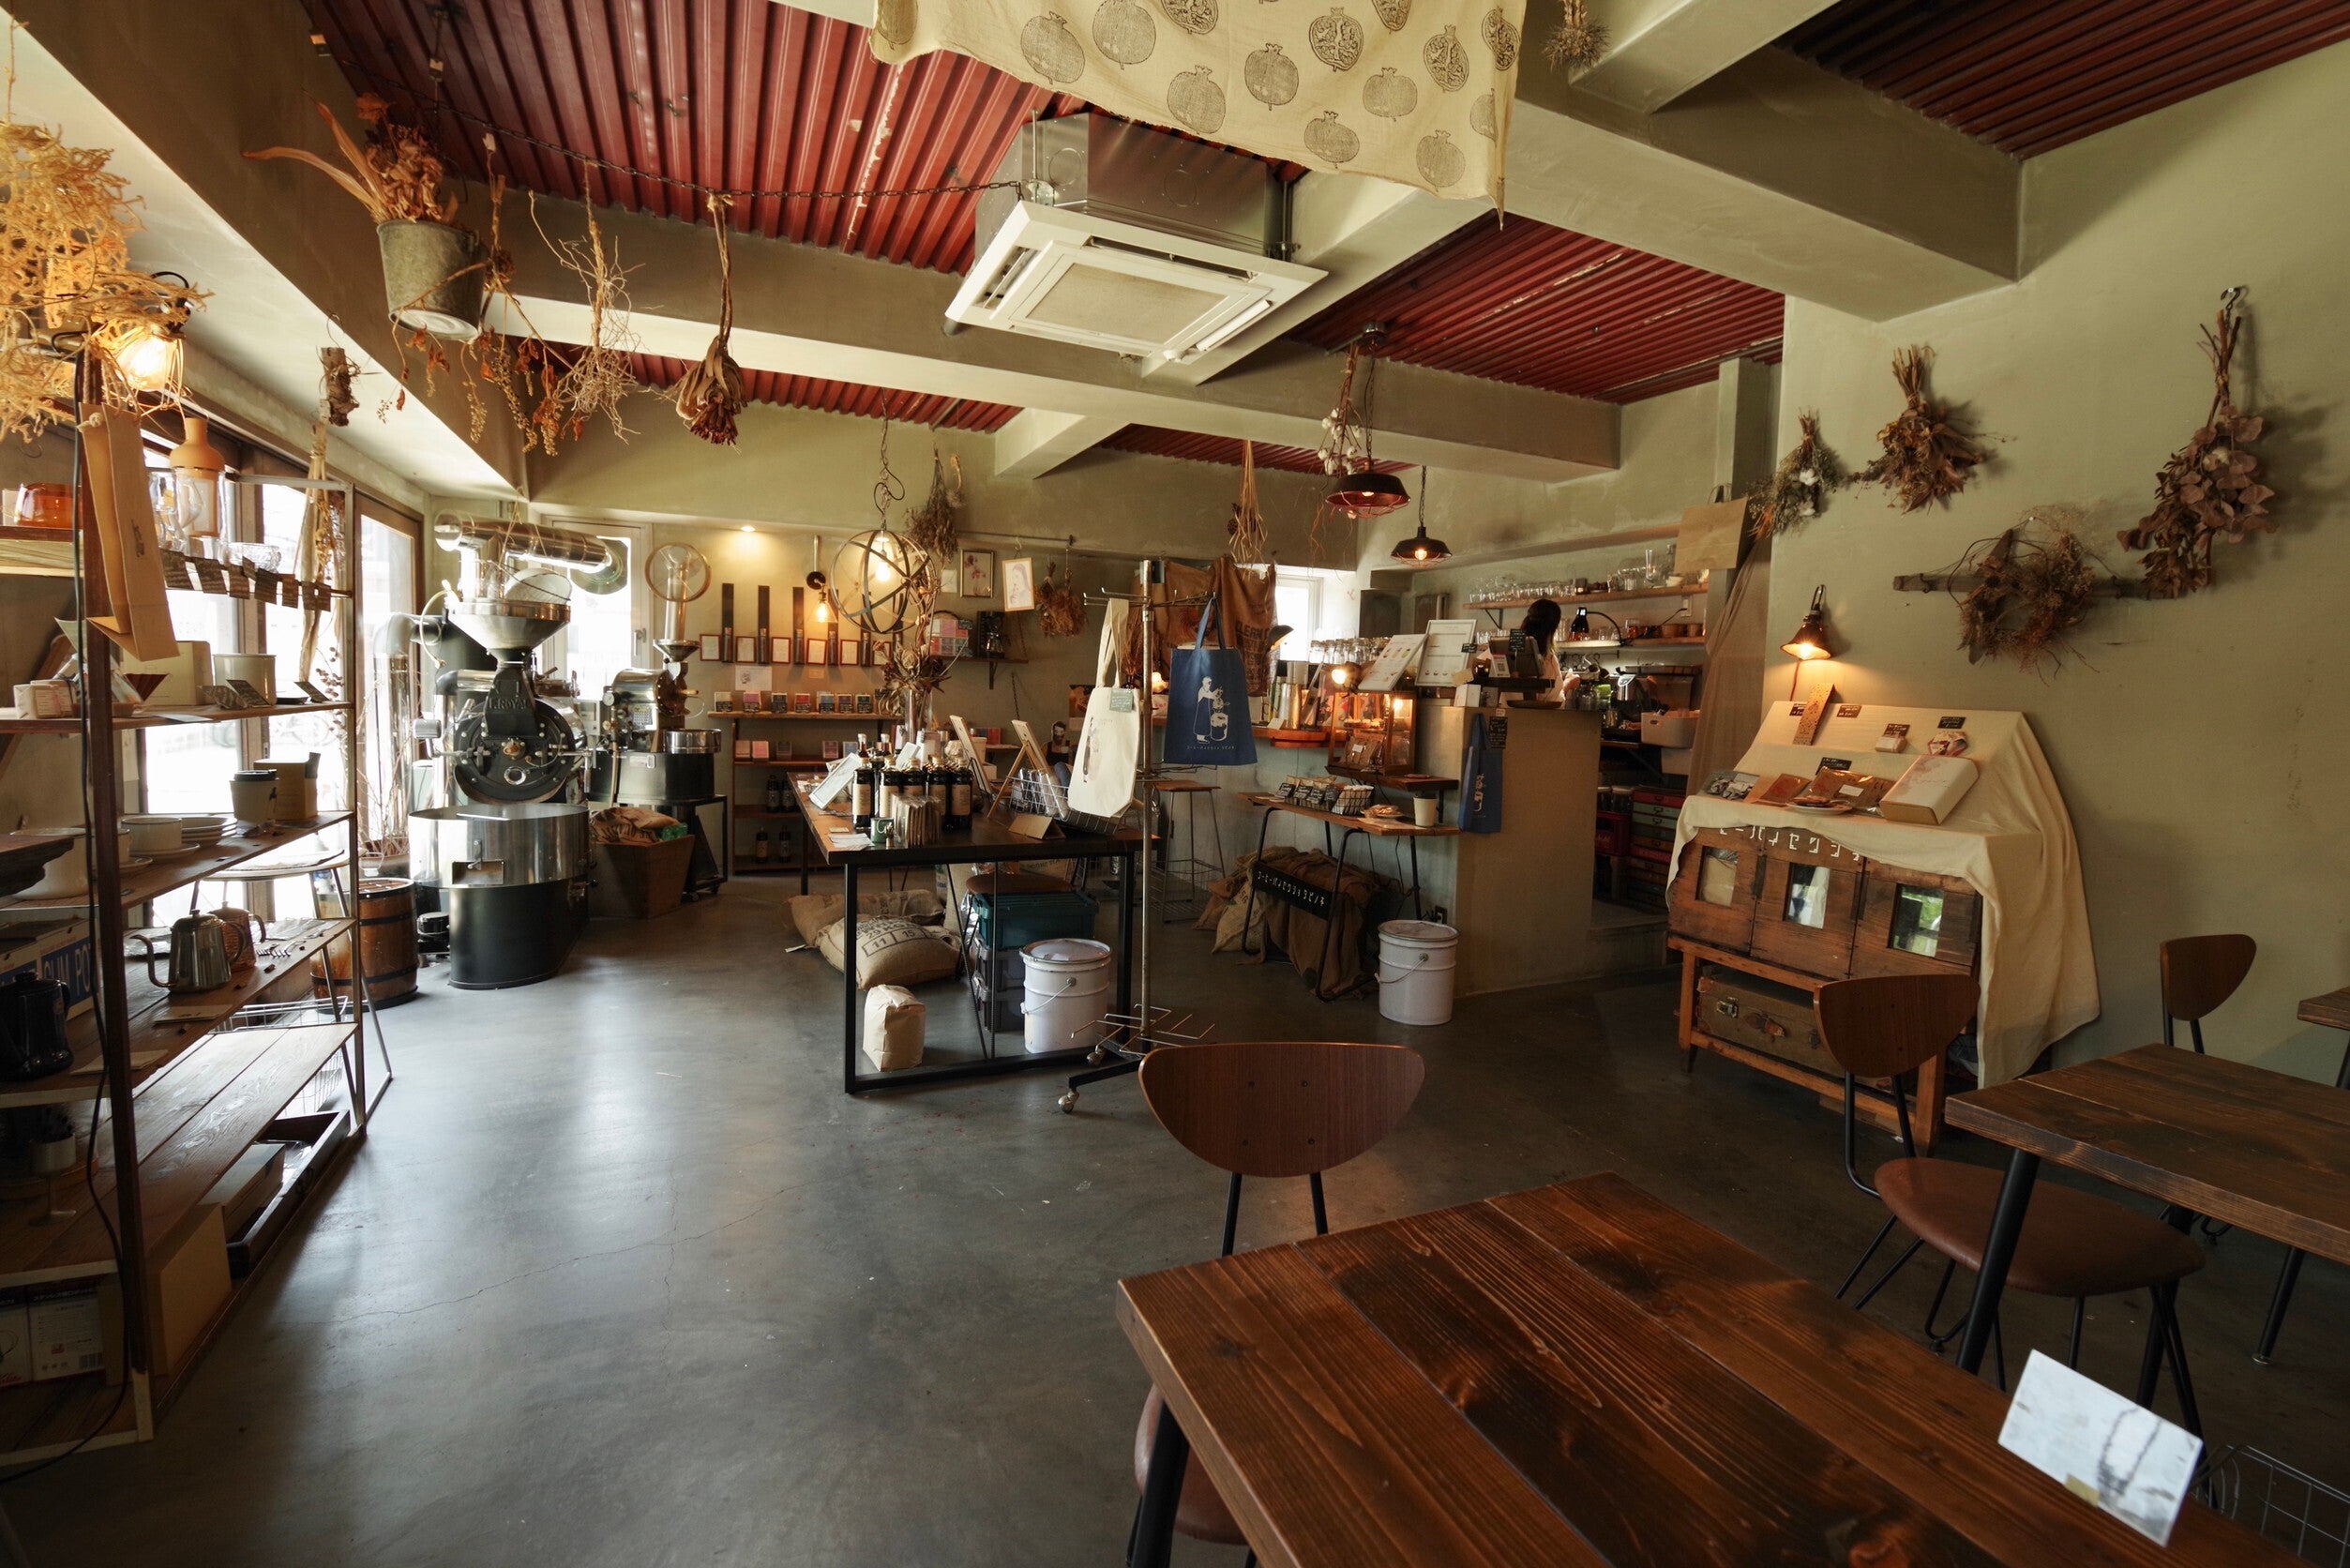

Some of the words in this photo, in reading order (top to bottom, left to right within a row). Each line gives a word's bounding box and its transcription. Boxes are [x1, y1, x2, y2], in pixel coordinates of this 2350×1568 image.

[902, 929, 916, 938] 15
[872, 938, 887, 948] 11
[75, 943, 91, 996] PO
